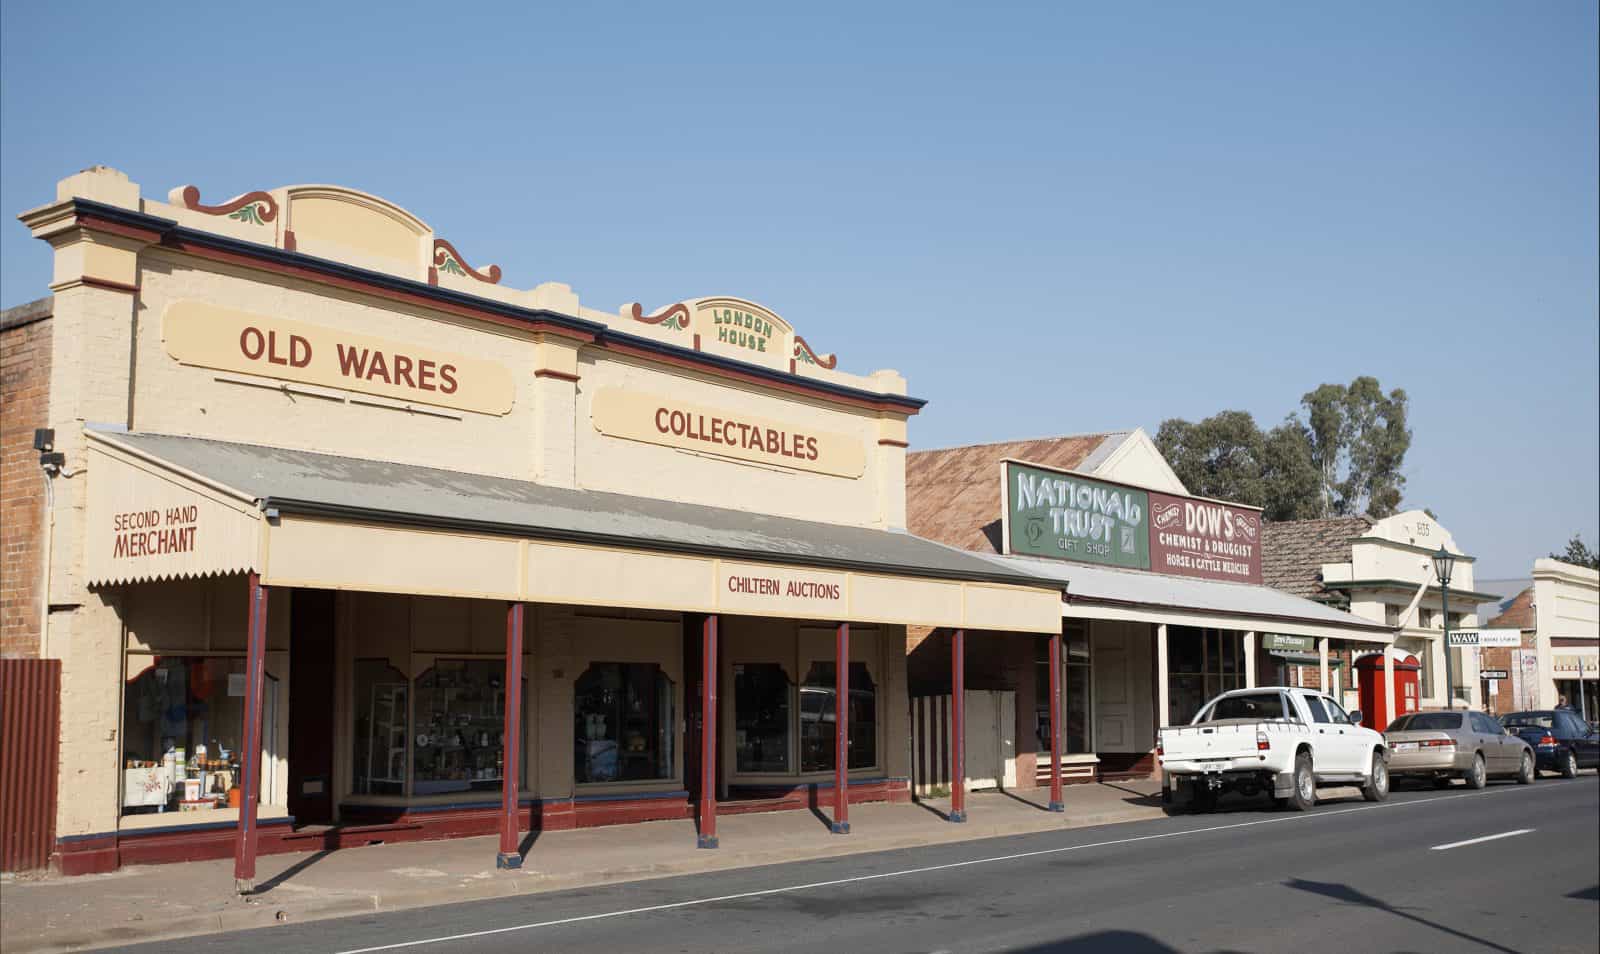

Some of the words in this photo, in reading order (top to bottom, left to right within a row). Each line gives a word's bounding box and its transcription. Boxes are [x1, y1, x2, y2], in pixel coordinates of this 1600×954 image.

[713, 308, 773, 340] LONDON
[718, 327, 767, 353] HOUSE
[239, 326, 313, 369] OLD
[336, 343, 459, 395] WARES
[654, 407, 819, 462] COLLECTABLES
[1017, 472, 1141, 527] NATIONAL
[113, 509, 161, 532] SECOND
[165, 504, 199, 526] HAND
[1049, 507, 1115, 542] TRUST
[1184, 502, 1235, 539] DOW'S
[112, 525, 198, 559] MERCHANT
[1057, 538, 1080, 553] GIFT
[1086, 542, 1111, 557] SHOP
[1159, 532, 1202, 551] CHEMIST
[1204, 538, 1211, 552] &
[1212, 540, 1253, 558] DRUGGIST
[1166, 553, 1191, 568] HORSE
[1196, 558, 1221, 572] CATTLE
[728, 575, 781, 596] CHILTERN
[786, 580, 841, 601] AUCTIONS
[1451, 632, 1479, 644] WAW
